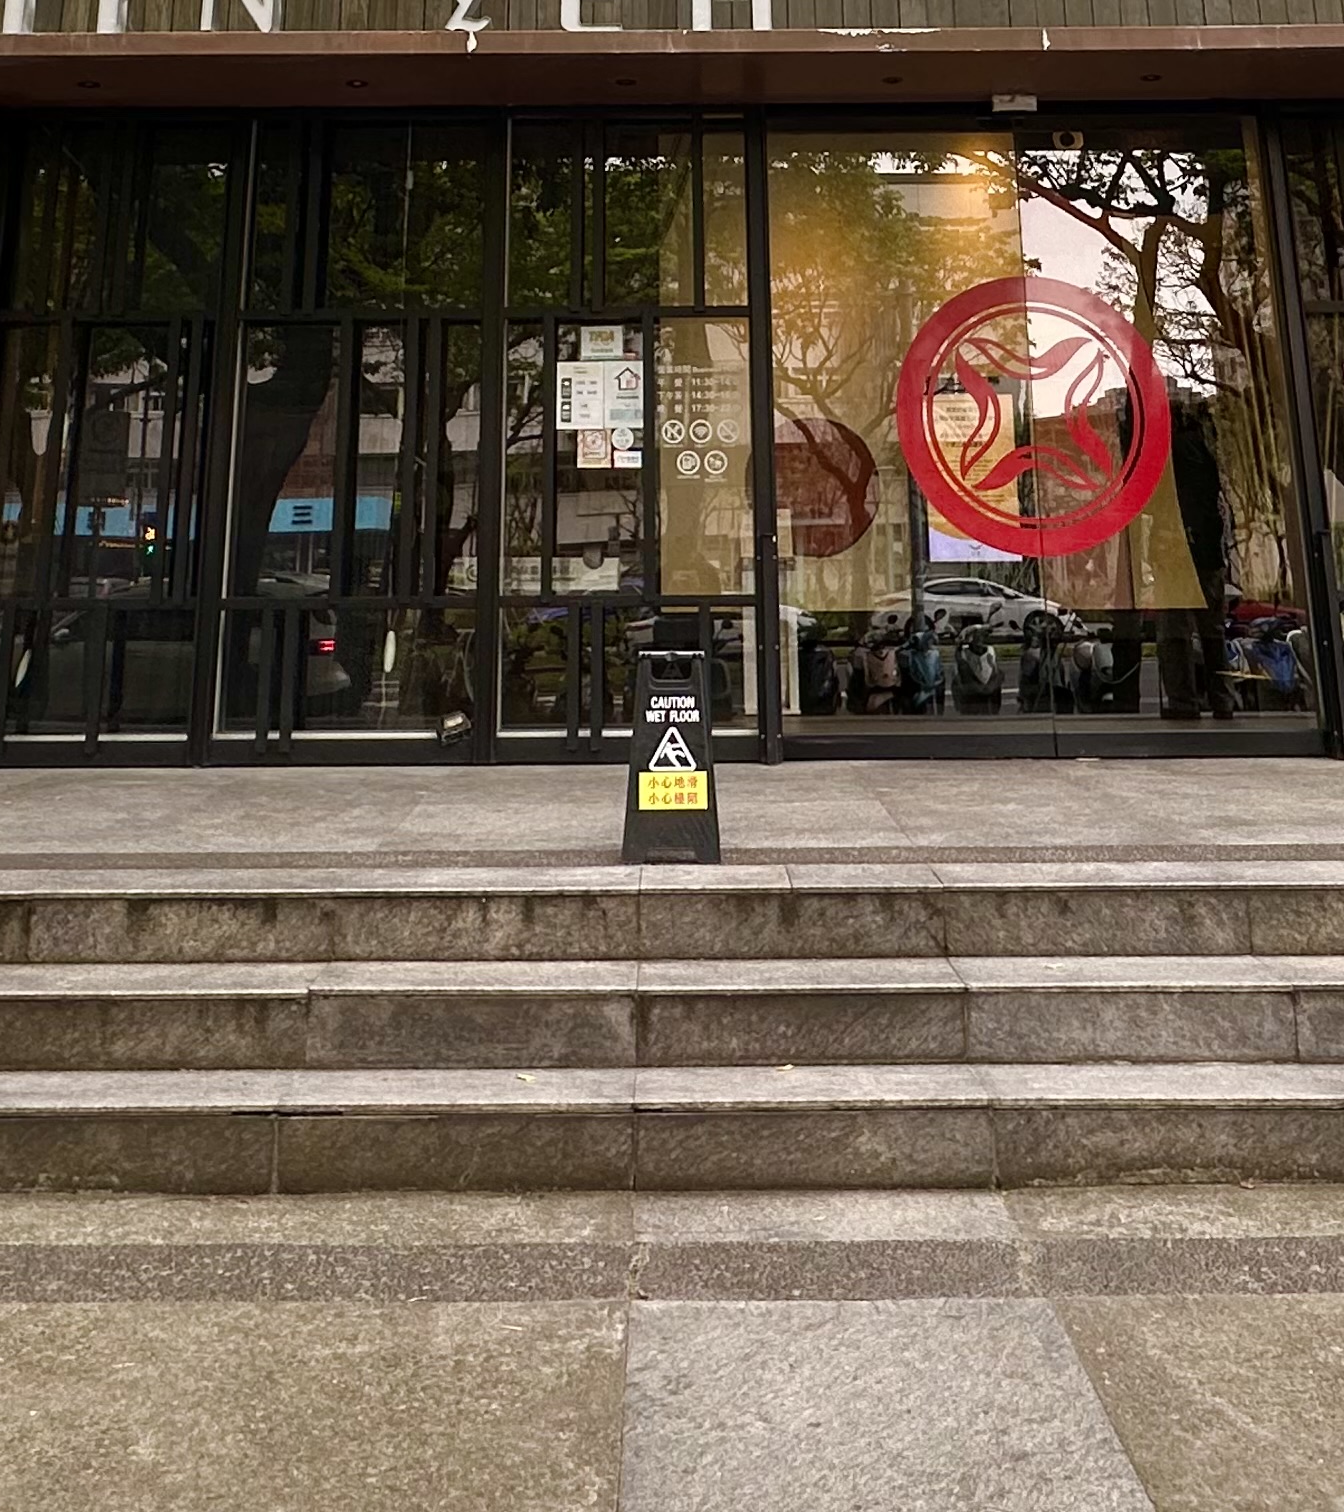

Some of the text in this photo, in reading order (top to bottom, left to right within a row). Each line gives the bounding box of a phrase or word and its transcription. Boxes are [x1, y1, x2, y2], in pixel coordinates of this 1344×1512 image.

[650, 696, 695, 709] CAUTION
[645, 710, 700, 723] WET FLOOR
[648, 776, 698, 789] 小心地滑
